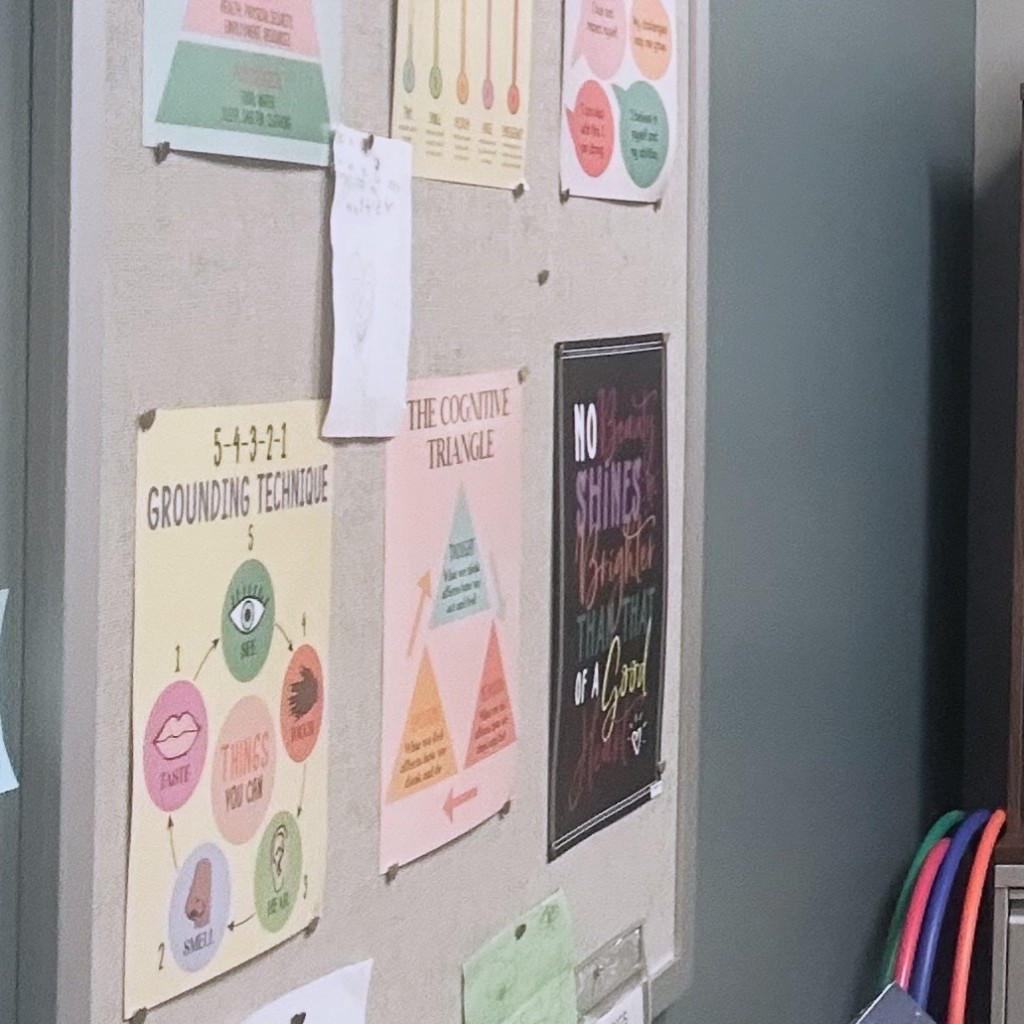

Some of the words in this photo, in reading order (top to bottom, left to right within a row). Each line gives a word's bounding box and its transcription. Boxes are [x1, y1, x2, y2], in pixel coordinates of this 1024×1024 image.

[407, 397, 437, 431] THE
[440, 387, 511, 426] COGNITIVE
[213, 422, 287, 467] 5-4-3-2-1
[426, 429, 496, 470] TRIANGLE
[573, 402, 598, 462] NO
[147, 475, 250, 530] GROUNDING
[257, 464, 329, 514] TECHNIQUE
[247, 524, 254, 551] 5
[574, 668, 588, 706] OF
[590, 661, 599, 699] A
[601, 616, 653, 743] Good
[221, 731, 269, 782] THINGS
[160, 765, 191, 791] TASTE
[224, 783, 244, 813] YOU
[245, 776, 264, 803] CAN
[157, 942, 165, 971] 2
[182, 928, 216, 956] SMELL
